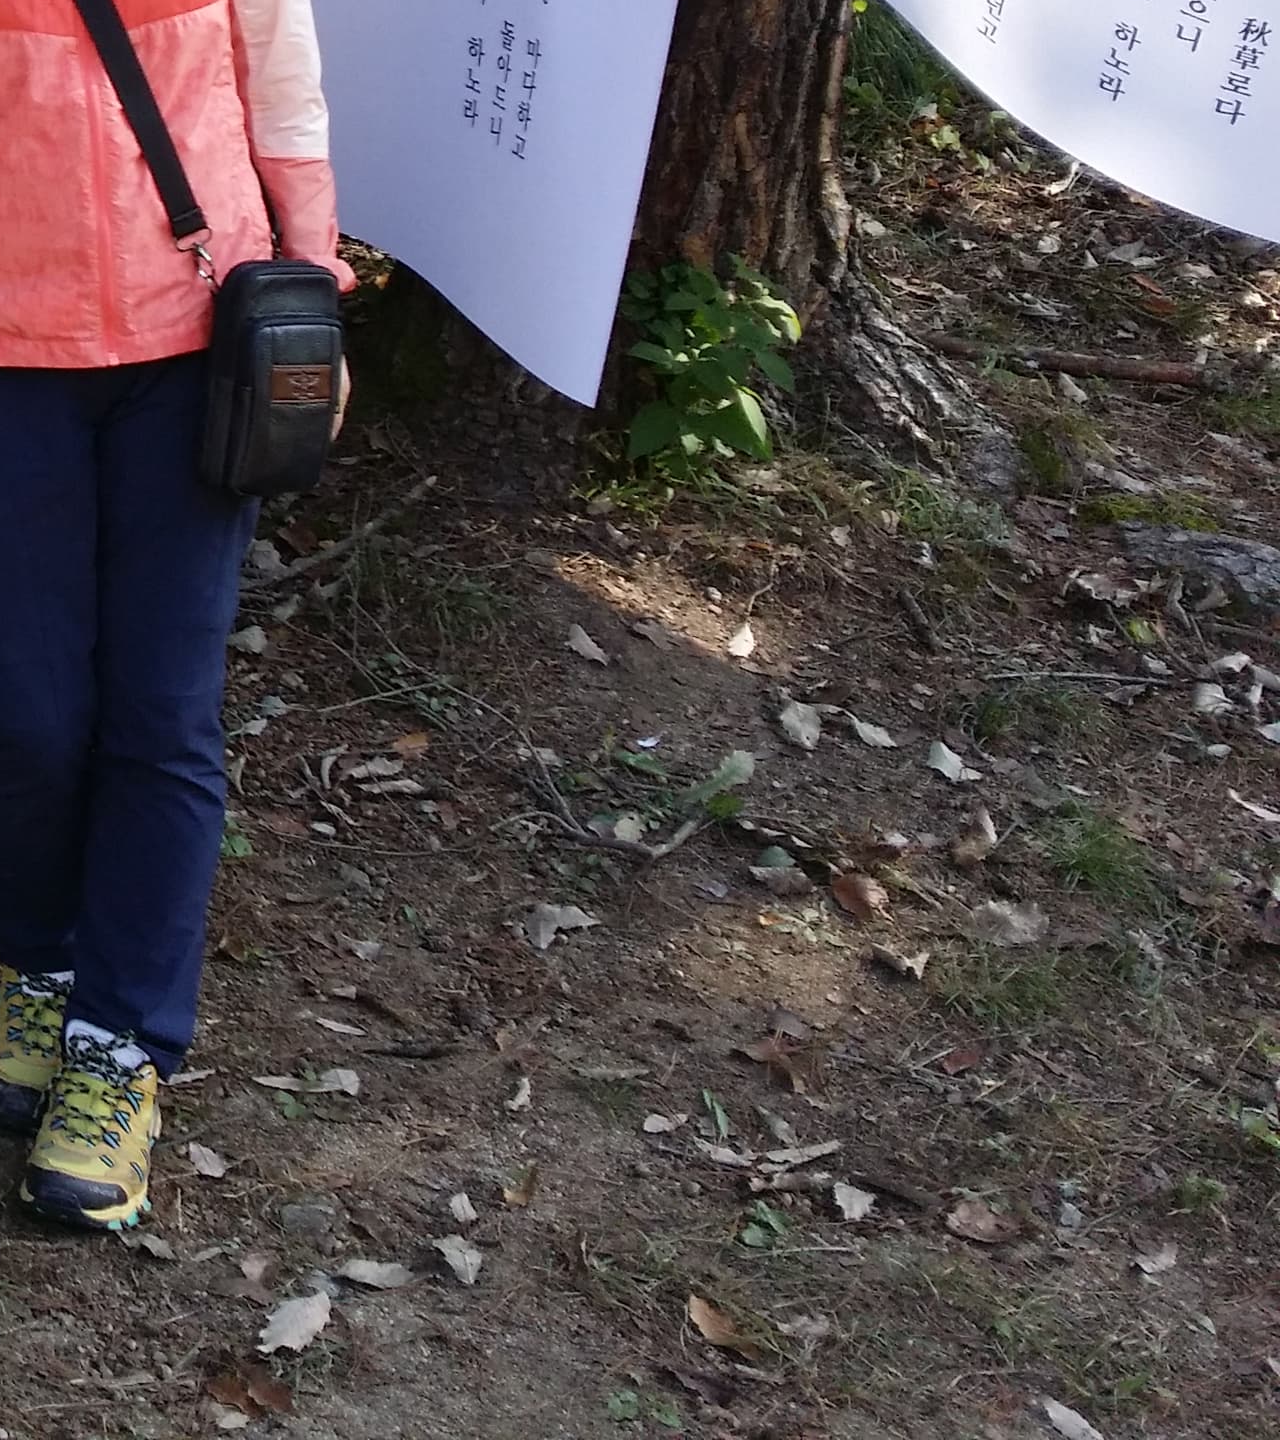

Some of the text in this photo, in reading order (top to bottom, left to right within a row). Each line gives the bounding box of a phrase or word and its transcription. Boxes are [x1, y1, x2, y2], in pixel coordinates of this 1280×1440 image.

[463, 37, 486, 128] 하노라
[511, 38, 542, 160] 마다하고
[1098, 21, 1142, 102] 하노라
[1215, 17, 1272, 125] 秋草로다
